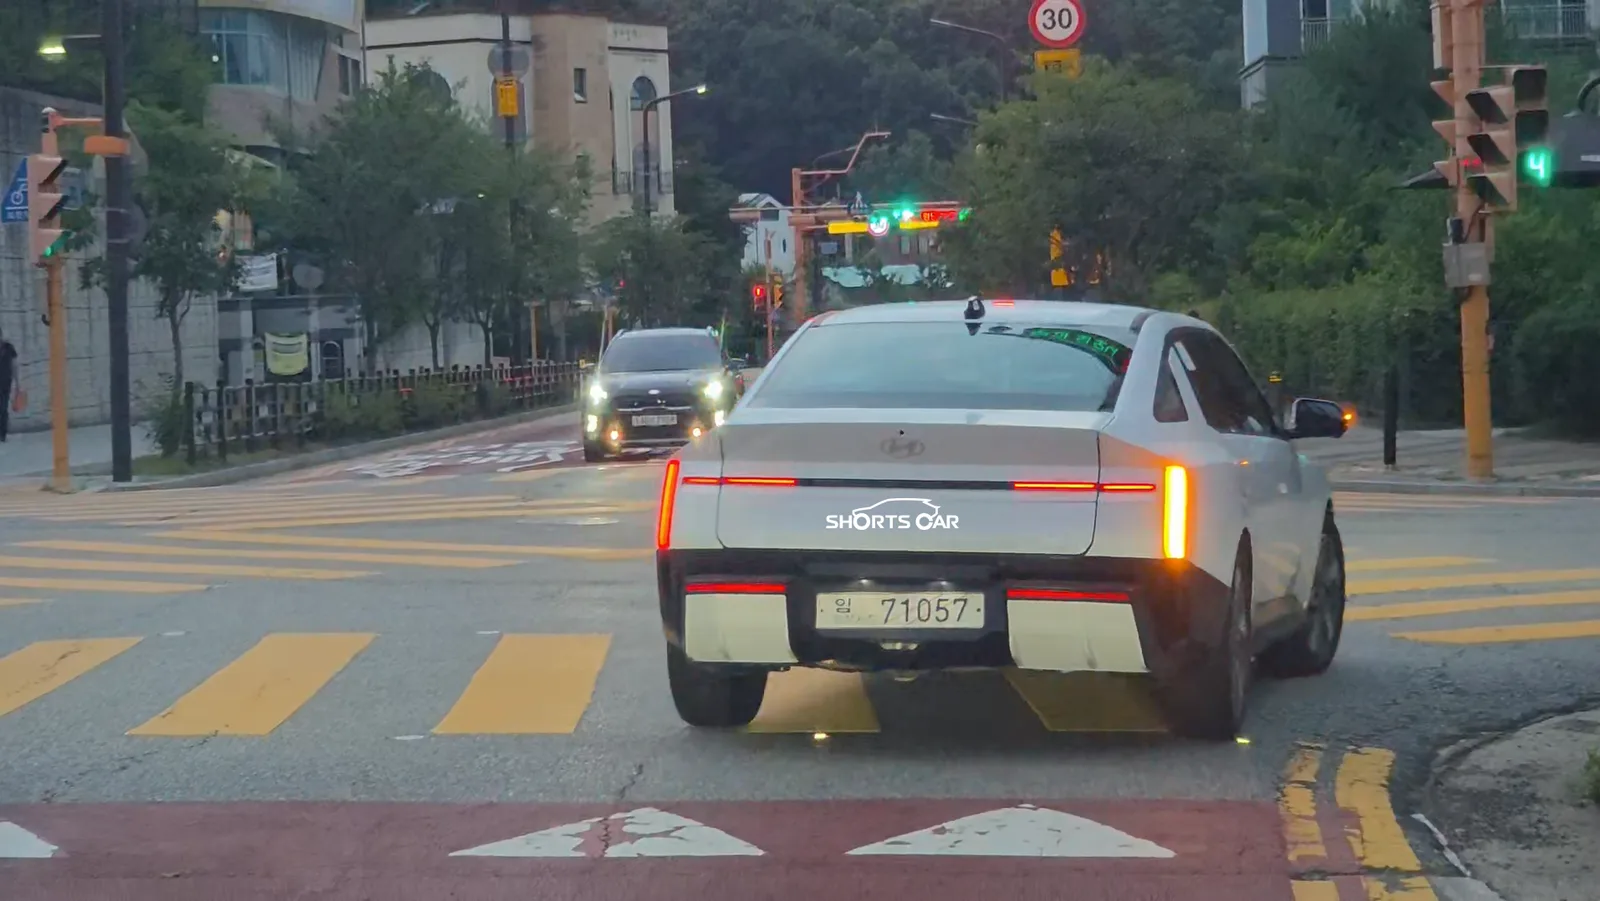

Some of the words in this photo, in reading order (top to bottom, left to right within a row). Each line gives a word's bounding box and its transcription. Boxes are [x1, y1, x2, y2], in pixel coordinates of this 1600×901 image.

[1042, 8, 1072, 30] 30
[1527, 152, 1546, 180] 4
[835, 598, 852, 614] 임
[882, 598, 969, 624] 71057
